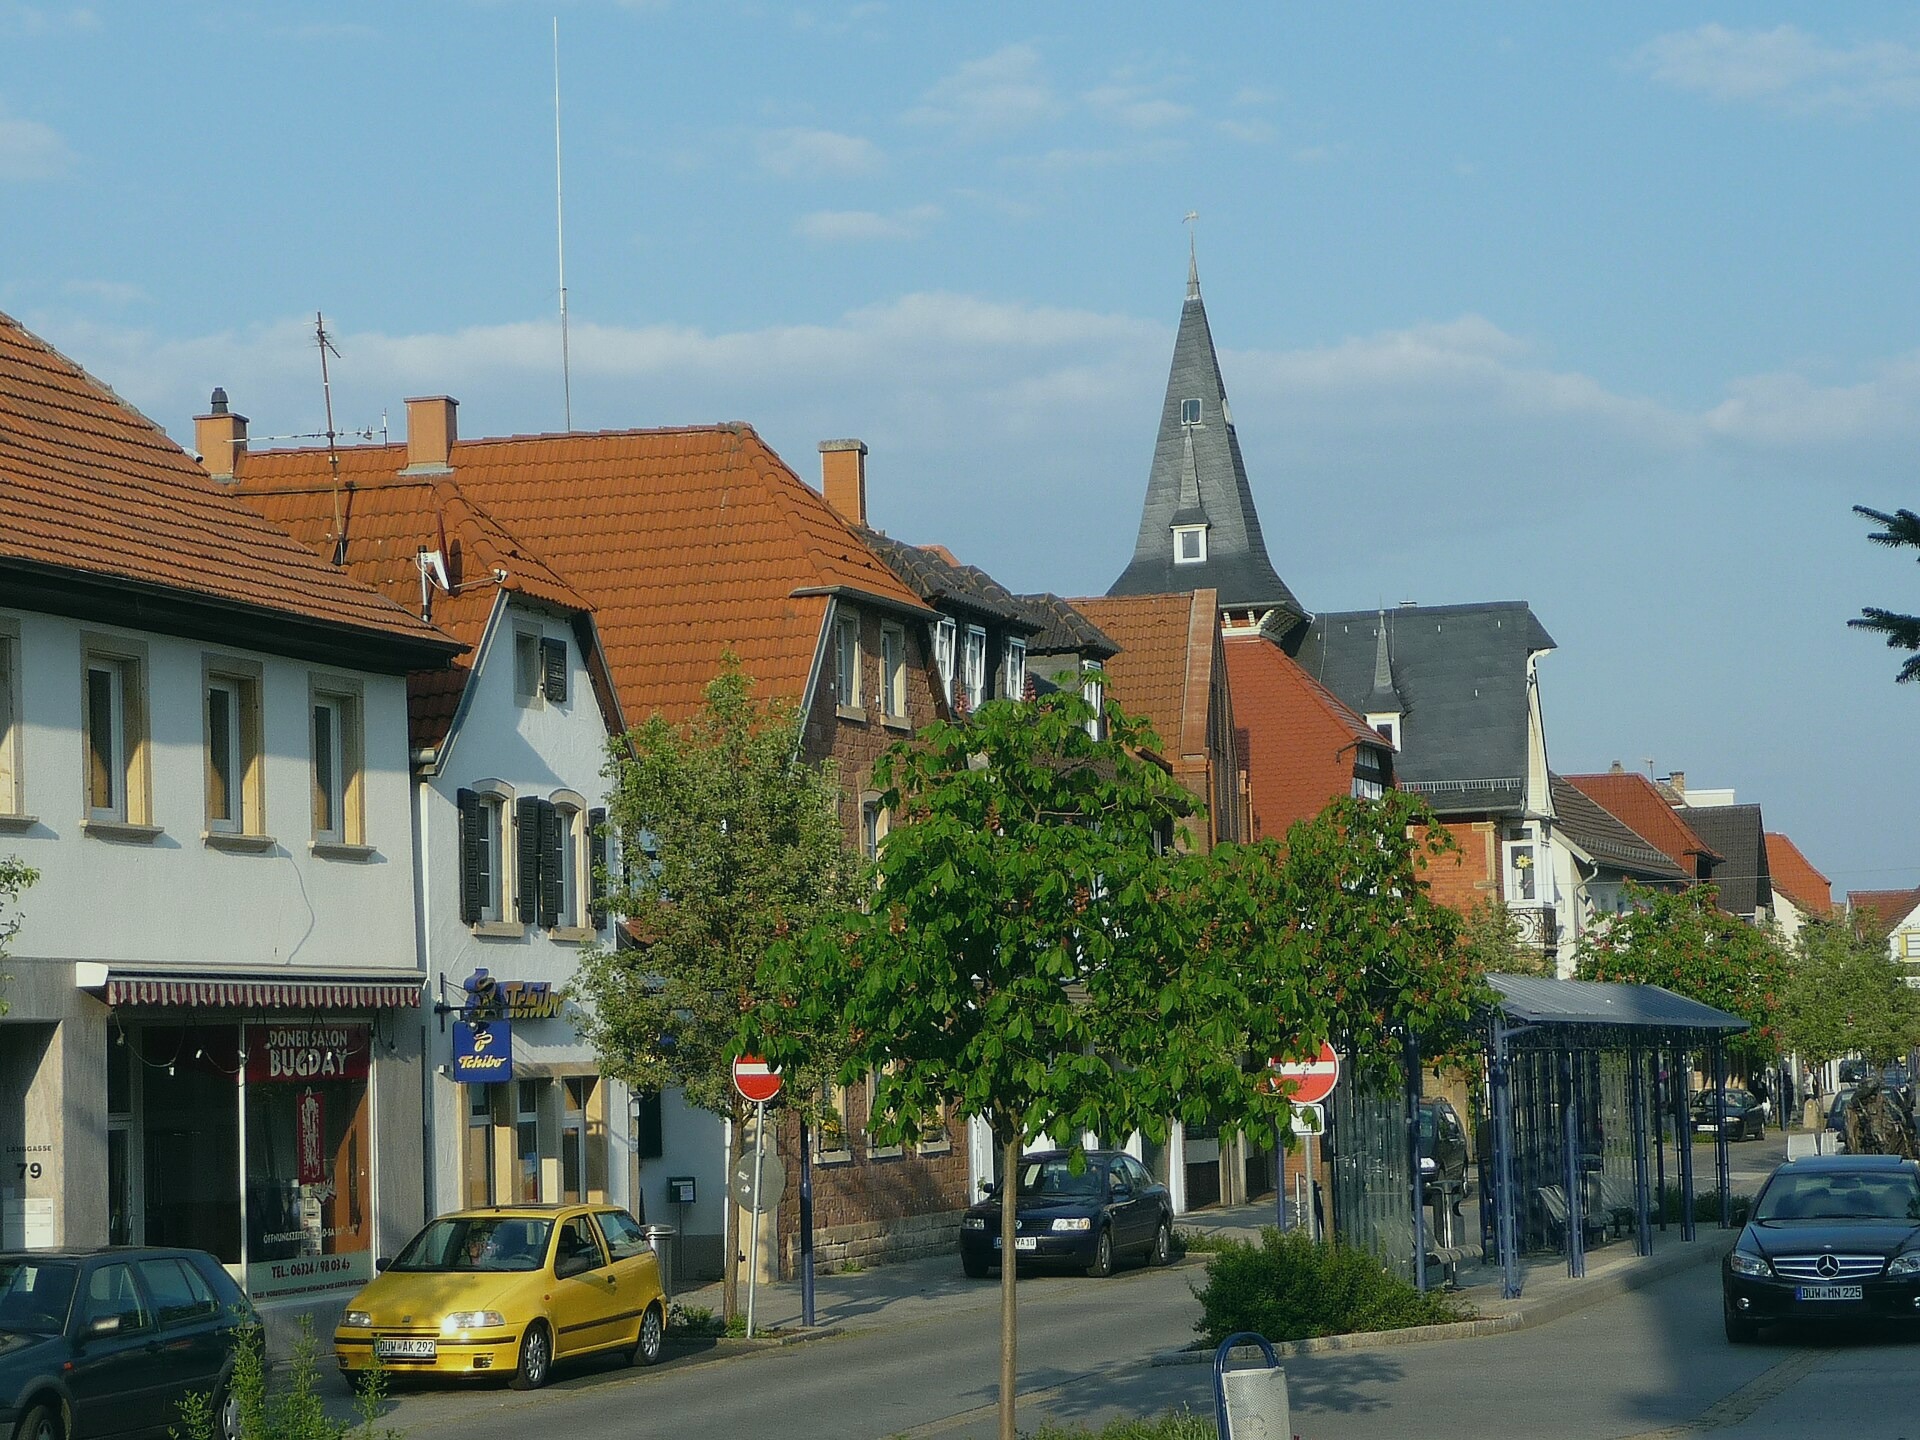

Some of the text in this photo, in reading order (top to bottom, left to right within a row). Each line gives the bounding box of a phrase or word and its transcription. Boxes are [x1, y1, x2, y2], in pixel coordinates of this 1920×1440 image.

[504, 981, 566, 1019] Tchibo
[269, 1026, 348, 1047] DÖNER SALON
[458, 1054, 507, 1069] Tchibo
[6, 1145, 52, 1153] LANGGASSE
[16, 1162, 42, 1179] 79
[1843, 1287, 1861, 1298] 225
[402, 1340, 414, 1352] AK
[416, 1341, 434, 1353] 292
